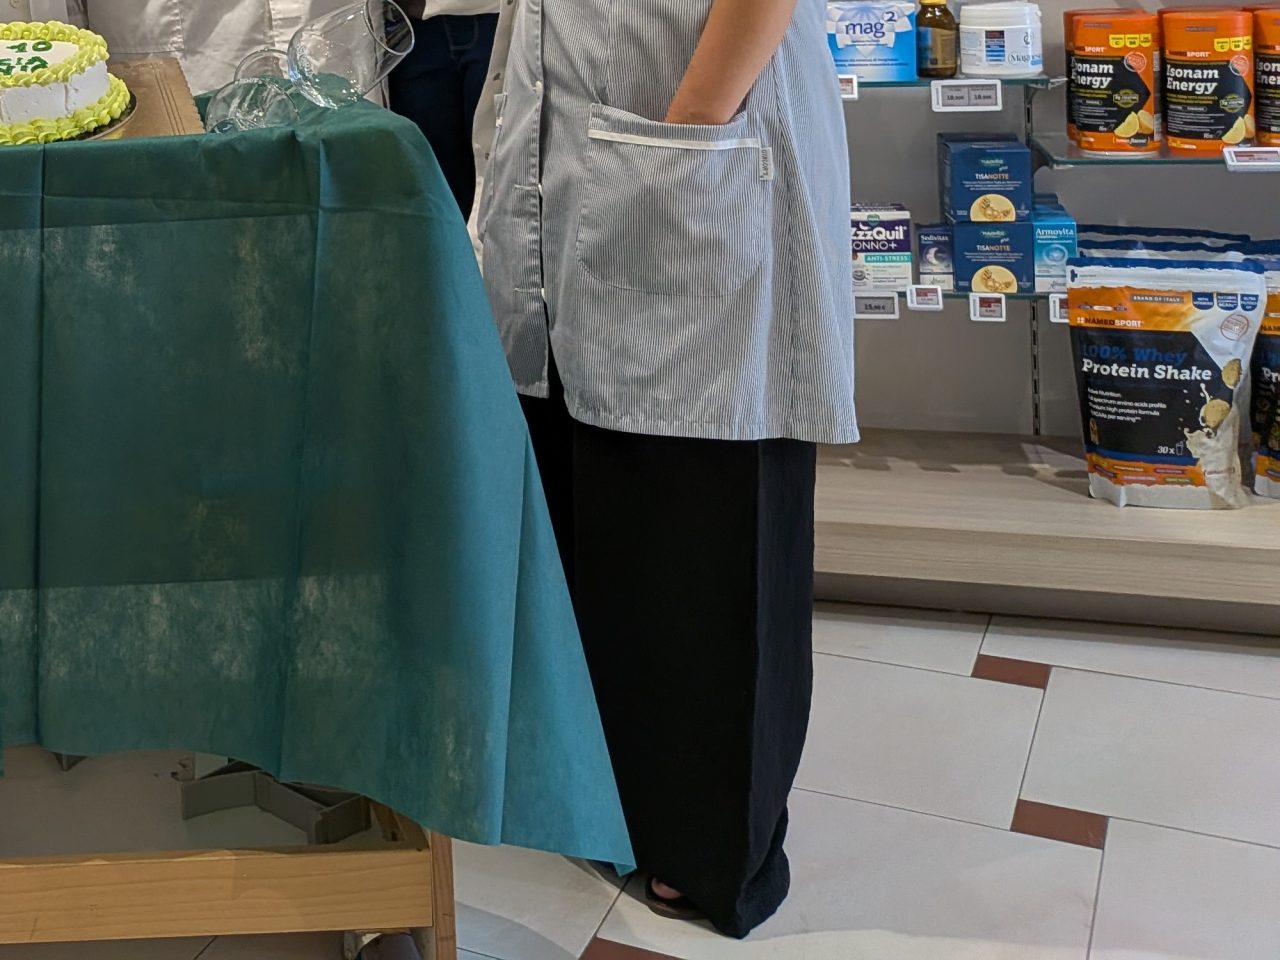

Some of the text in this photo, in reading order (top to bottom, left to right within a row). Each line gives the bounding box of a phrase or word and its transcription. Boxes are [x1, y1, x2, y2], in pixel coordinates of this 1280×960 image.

[845, 21, 886, 38] mag
[1166, 64, 1219, 79] Isonam
[1166, 78, 1218, 95] Energy
[1035, 228, 1074, 237] Armovita
[1081, 358, 1213, 381] Protein Shake
